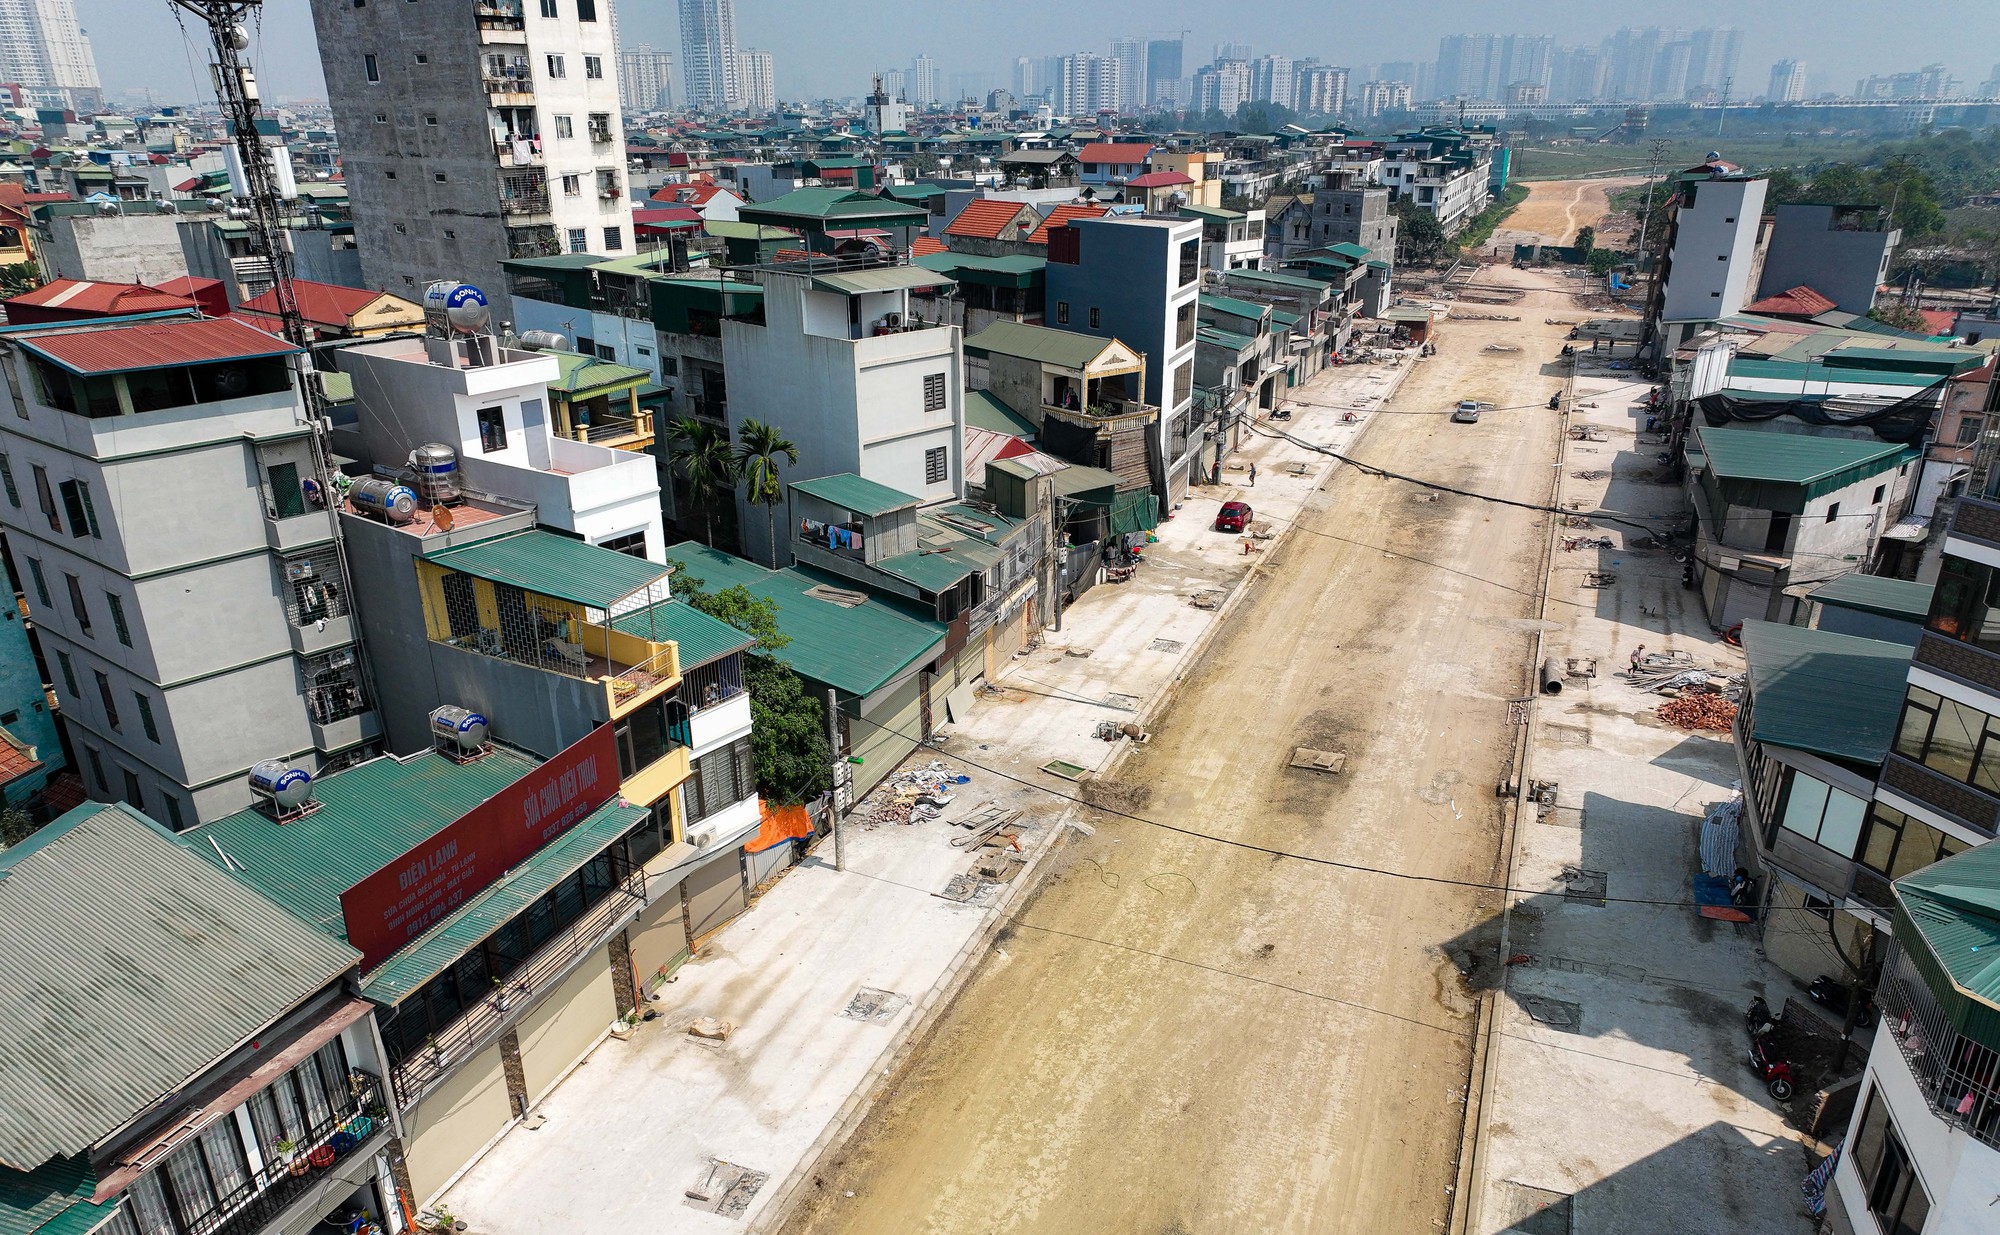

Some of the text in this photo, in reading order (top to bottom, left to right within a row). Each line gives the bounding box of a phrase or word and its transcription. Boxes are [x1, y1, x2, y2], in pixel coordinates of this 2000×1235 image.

[454, 288, 482, 302] SONHA
[280, 771, 306, 786] SONHA
[523, 753, 598, 830] SỬA CHỮA ĐIỆN THOẠI
[383, 904, 398, 920] SỬA
[459, 851, 477, 868] LẠNH
[399, 838, 458, 891] ĐIỆN LẠNH
[388, 915, 405, 931] BÌNH
[425, 887, 442, 906] LẠNH
[406, 913, 429, 936] 0912
[447, 888, 463, 906] 437
